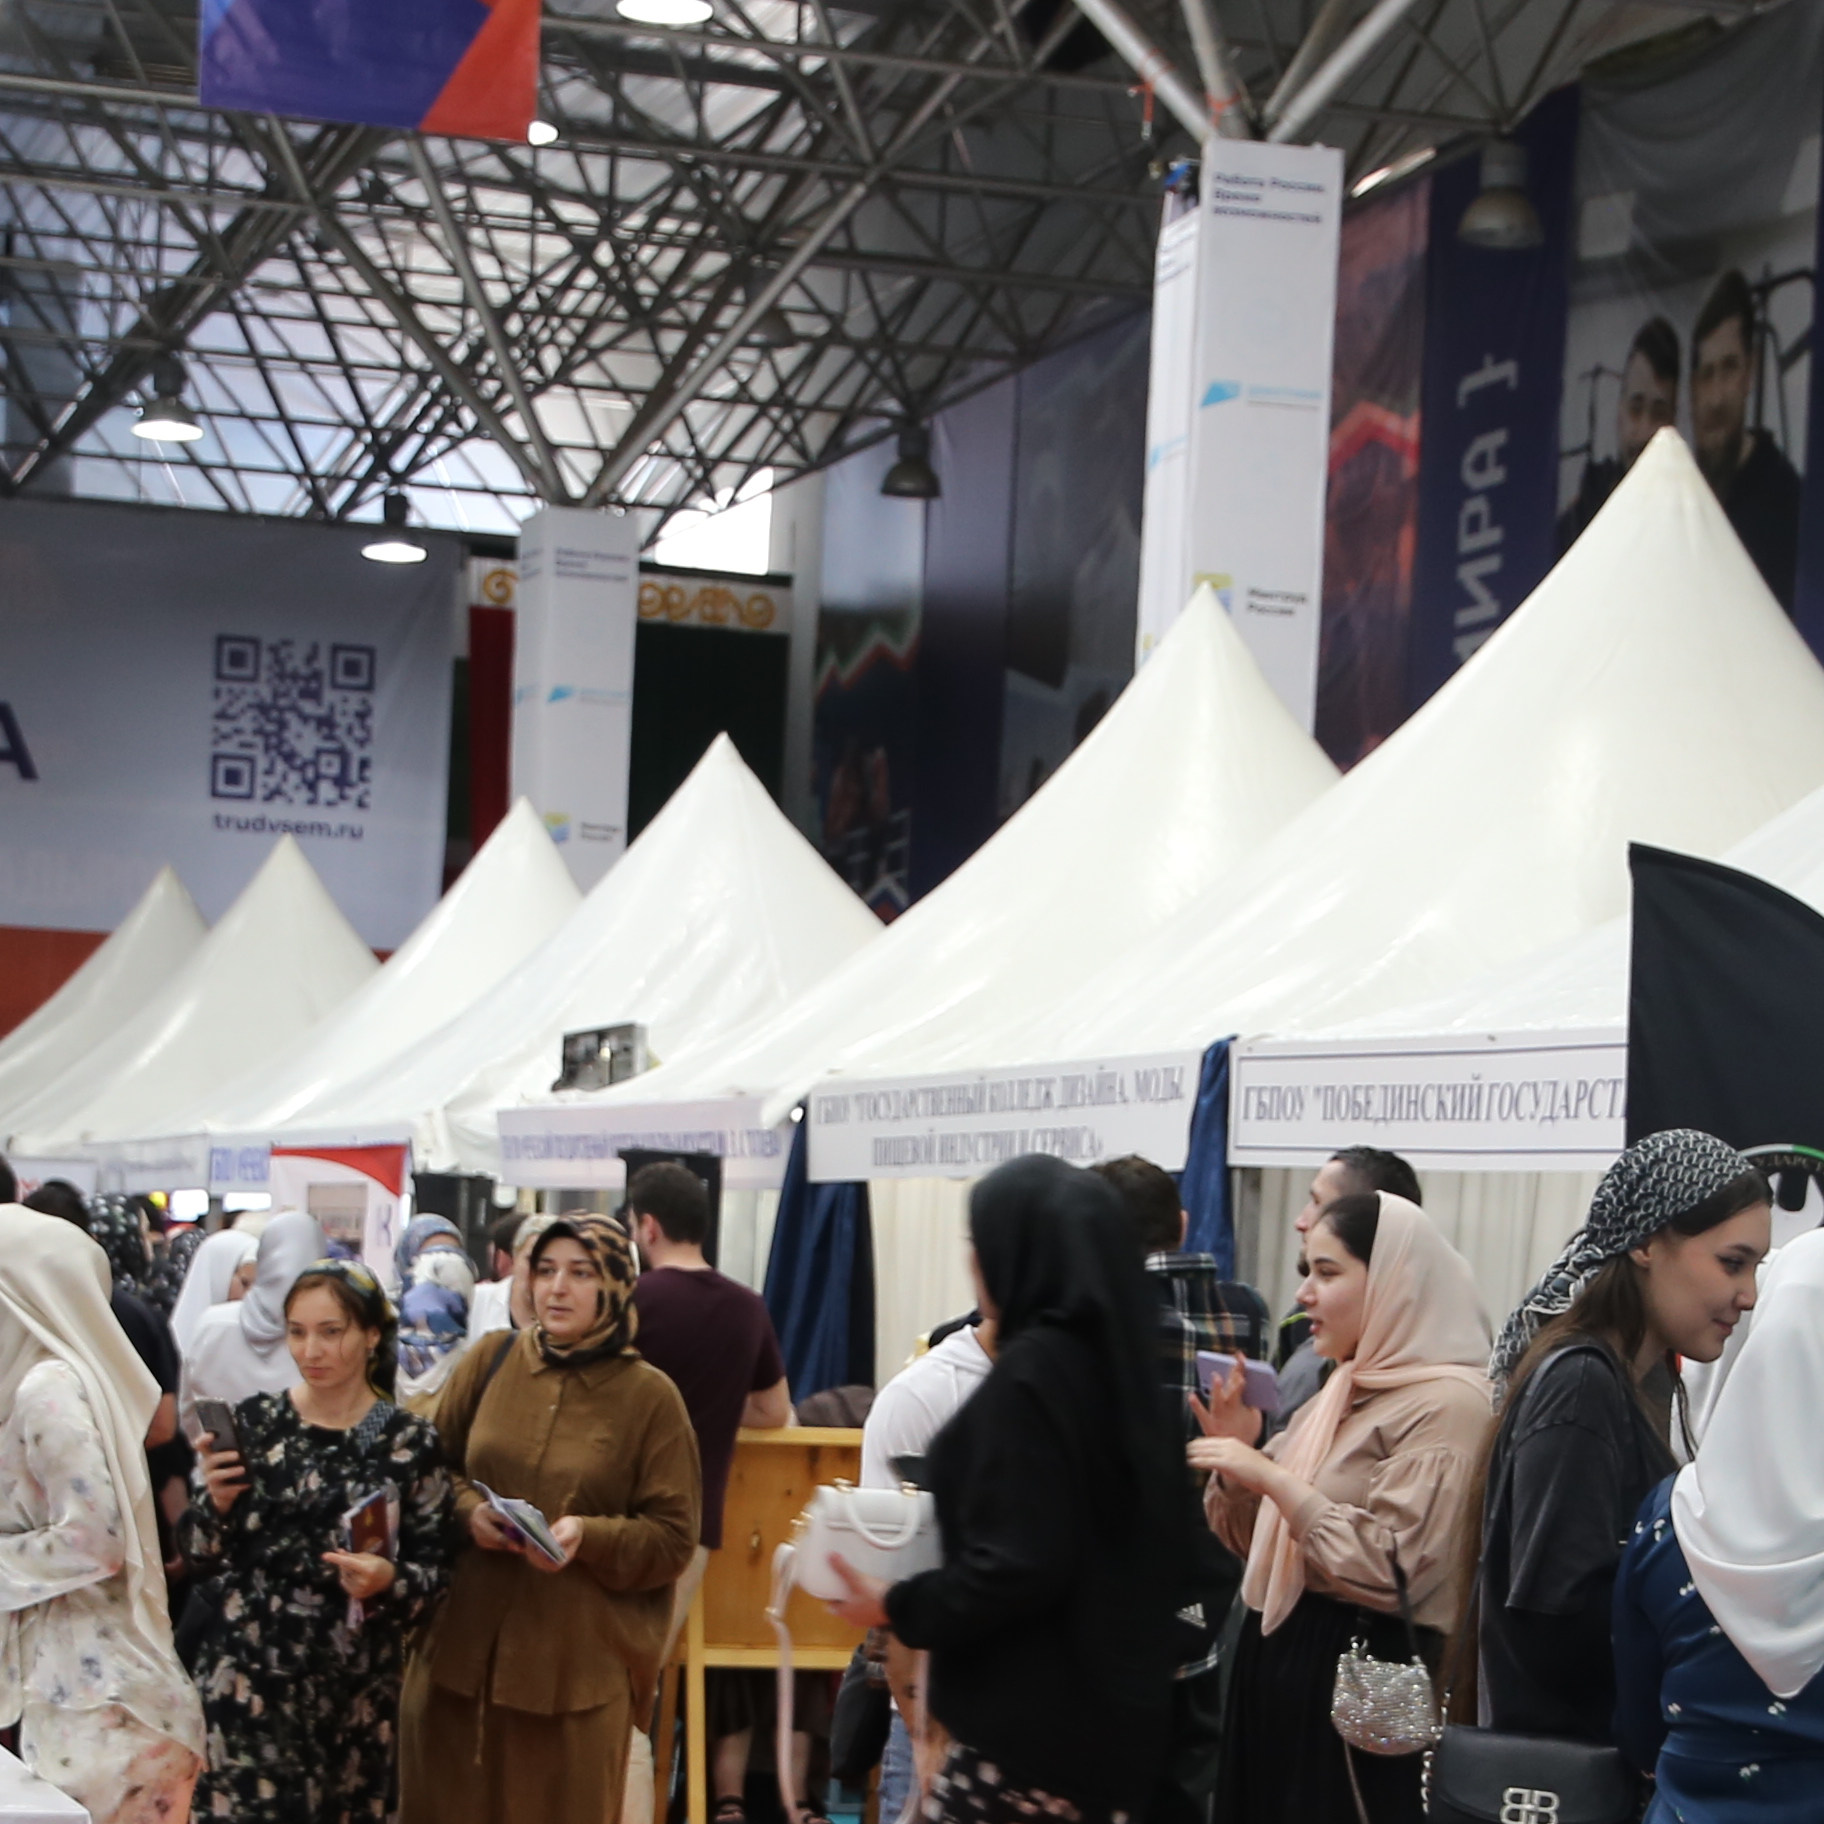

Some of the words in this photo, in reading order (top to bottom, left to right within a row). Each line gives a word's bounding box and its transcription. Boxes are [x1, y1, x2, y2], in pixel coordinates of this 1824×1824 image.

[215, 814, 363, 839] trudvsem.ru
[1242, 1084, 1306, 1121] ГБПОУ
[1485, 1077, 1626, 1124] ГОСУДАРСТ
